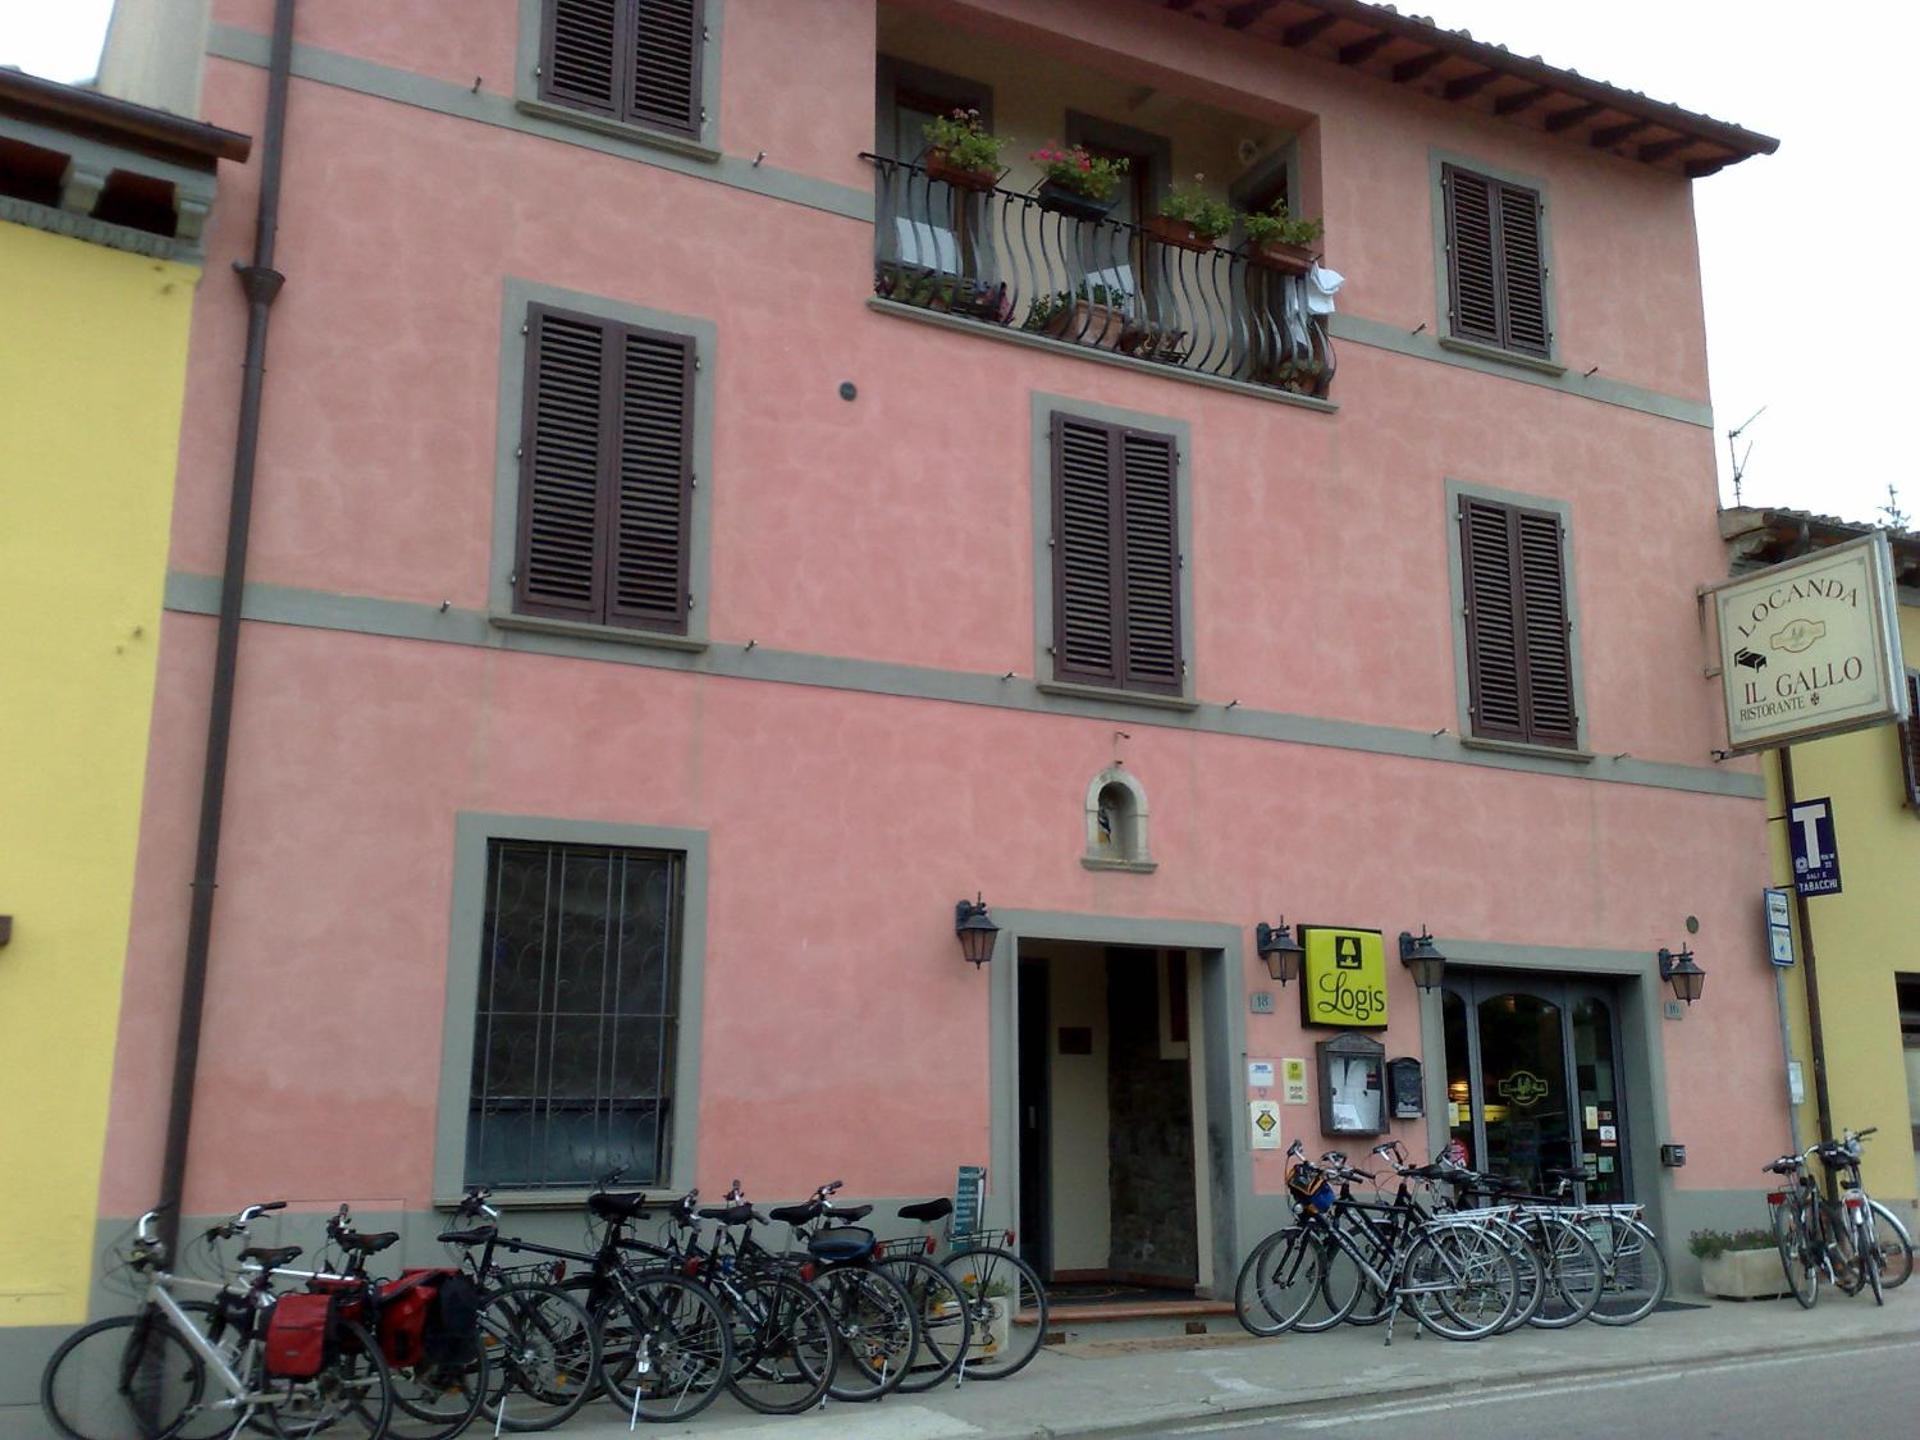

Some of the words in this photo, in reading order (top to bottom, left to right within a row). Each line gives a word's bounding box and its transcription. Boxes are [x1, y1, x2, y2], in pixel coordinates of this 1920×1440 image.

[1738, 578, 1857, 639] LOCANDA
[1745, 681, 1766, 705] IL
[1776, 656, 1862, 697] GALLO
[1740, 697, 1805, 722] RISTORANTE
[1792, 803, 1826, 868] T
[1799, 879, 1838, 892] TABACCHI
[1317, 971, 1385, 1020] Logis
